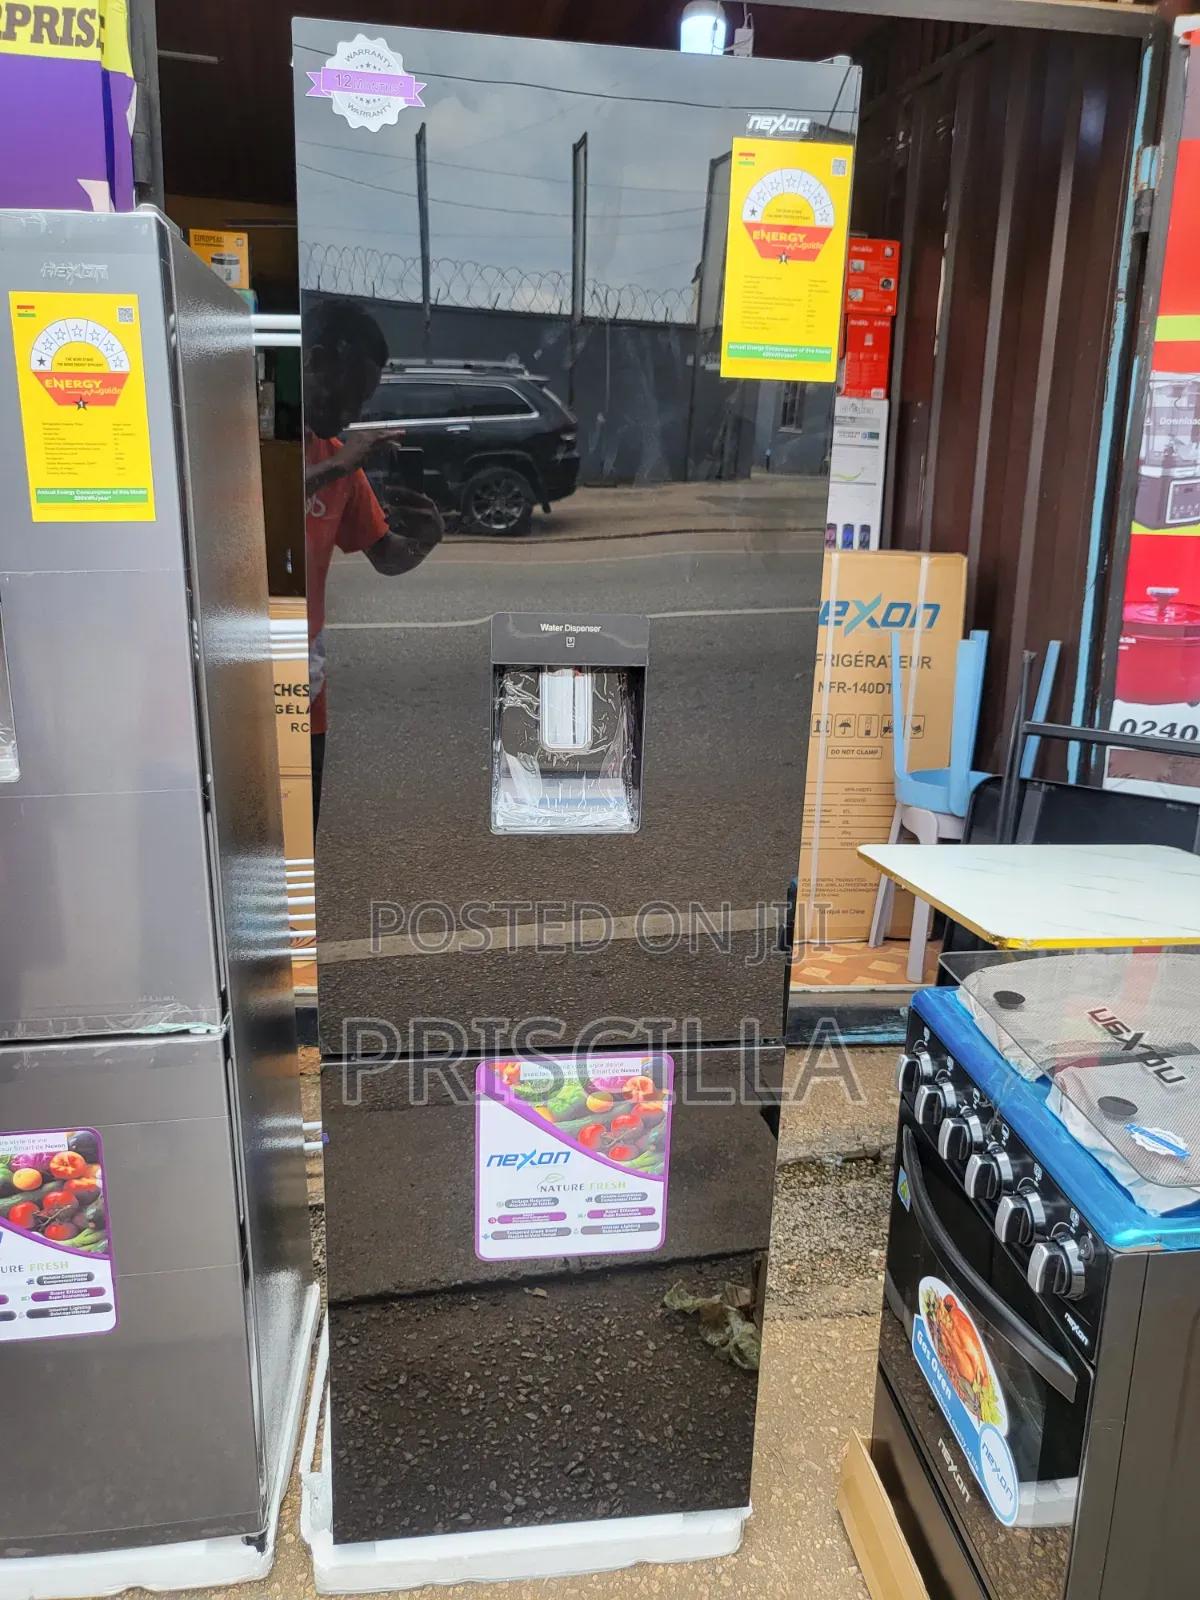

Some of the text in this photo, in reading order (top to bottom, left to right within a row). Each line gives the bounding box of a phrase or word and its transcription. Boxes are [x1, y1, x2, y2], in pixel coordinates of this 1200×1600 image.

[0, 2, 104, 55] PRIS
[345, 48, 392, 68] WARRANTY
[334, 73, 352, 88] 12
[347, 101, 391, 118] WARRANTY
[752, 228, 807, 243] ENERGY
[44, 377, 103, 391] ENERGY
[98, 386, 122, 396] guide
[818, 592, 941, 638] exon
[540, 623, 602, 634] Water Dispenser
[818, 681, 903, 695] NFR-140DT
[540, 1181, 626, 1193] NATURE FRESH
[29, 1261, 69, 1272] FRESH
[916, 1330, 952, 1400] Gas Oven
